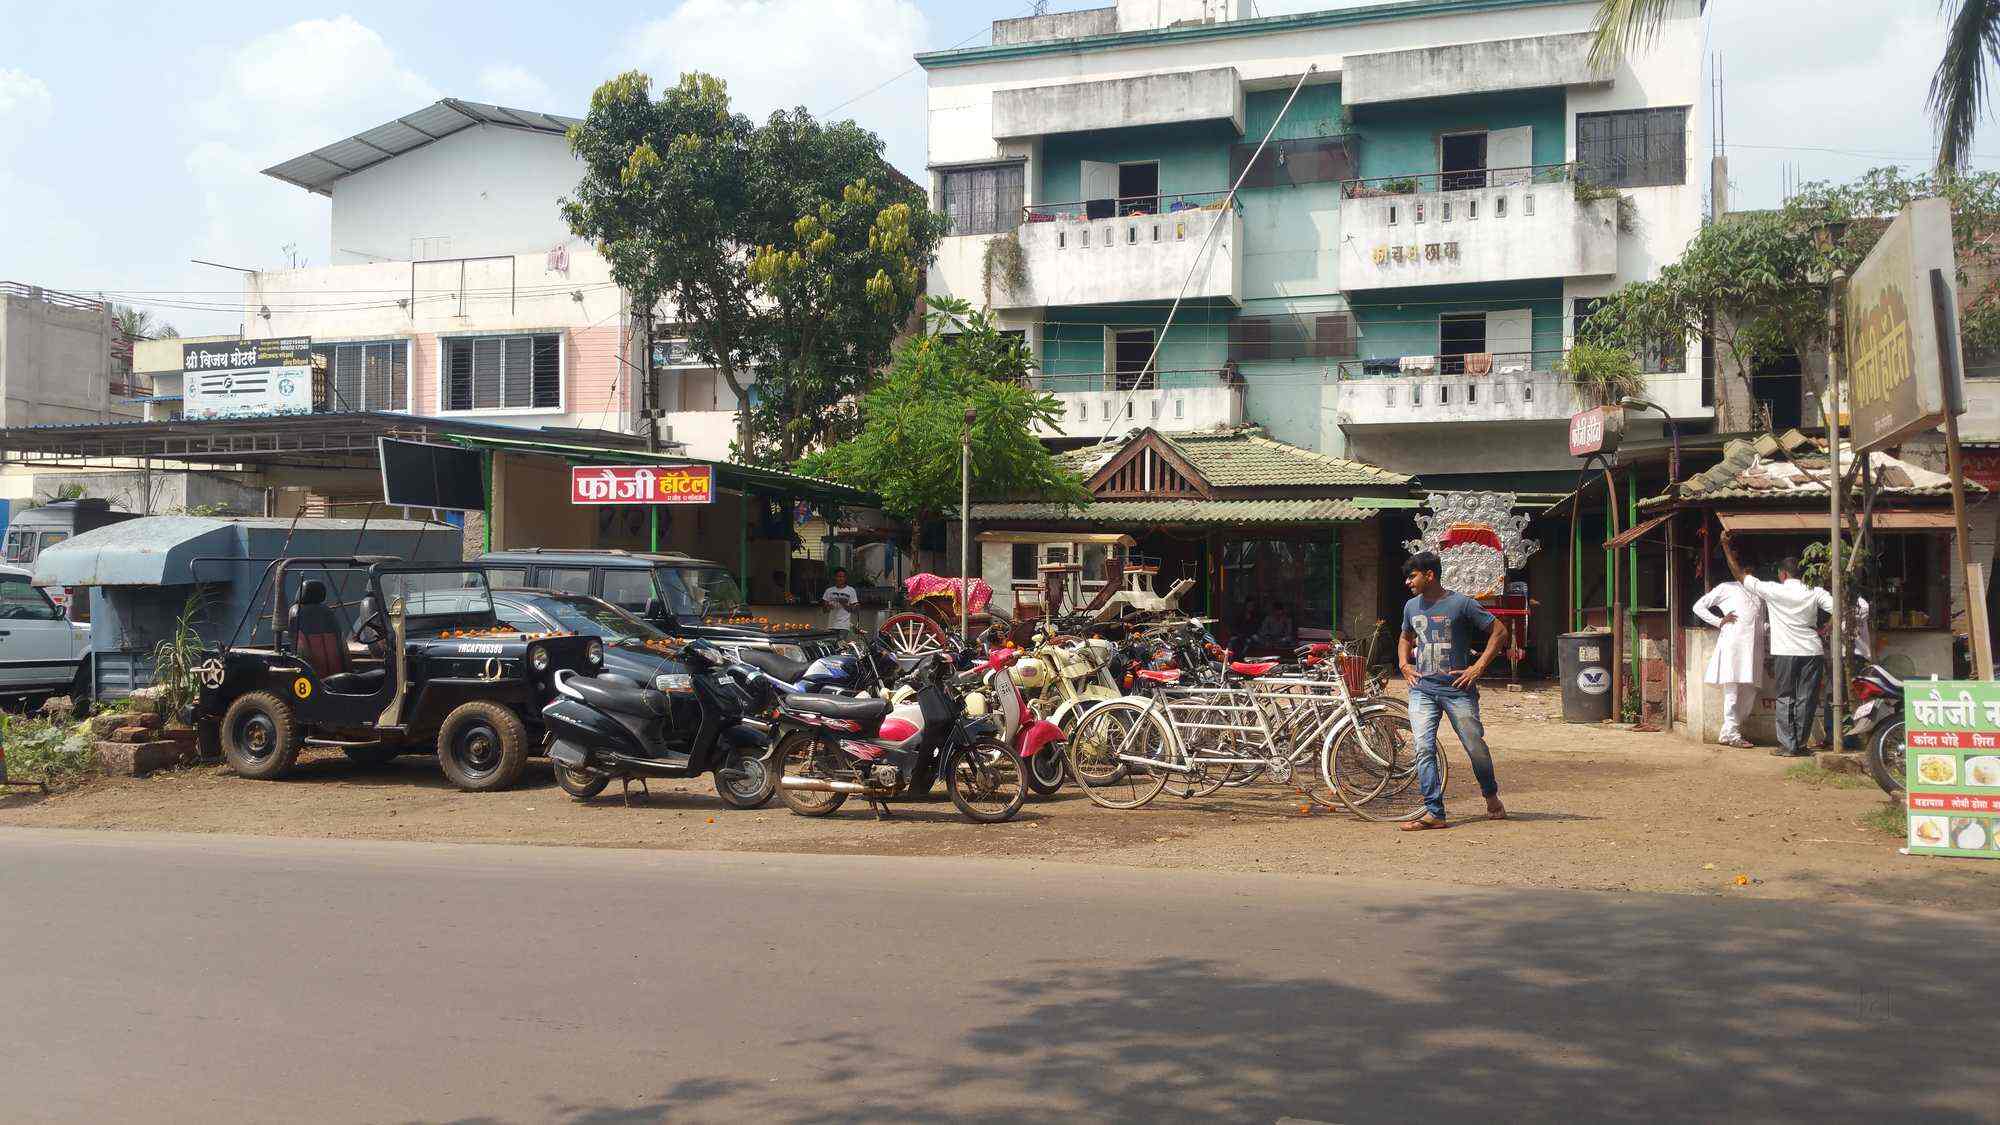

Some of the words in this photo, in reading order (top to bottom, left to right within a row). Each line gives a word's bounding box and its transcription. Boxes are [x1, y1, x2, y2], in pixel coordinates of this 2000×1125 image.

[186, 351, 198, 369] श्री
[200, 349, 229, 369] विजय
[230, 346, 257, 367] मोटर्स
[576, 469, 656, 500] फौजी
[659, 471, 710, 494] हॉटेल
[1913, 689, 1977, 728] फौजी
[1913, 732, 1938, 746] कांदा
[1941, 732, 1960, 748] पोहे
[1972, 733, 1995, 748] शिरा
